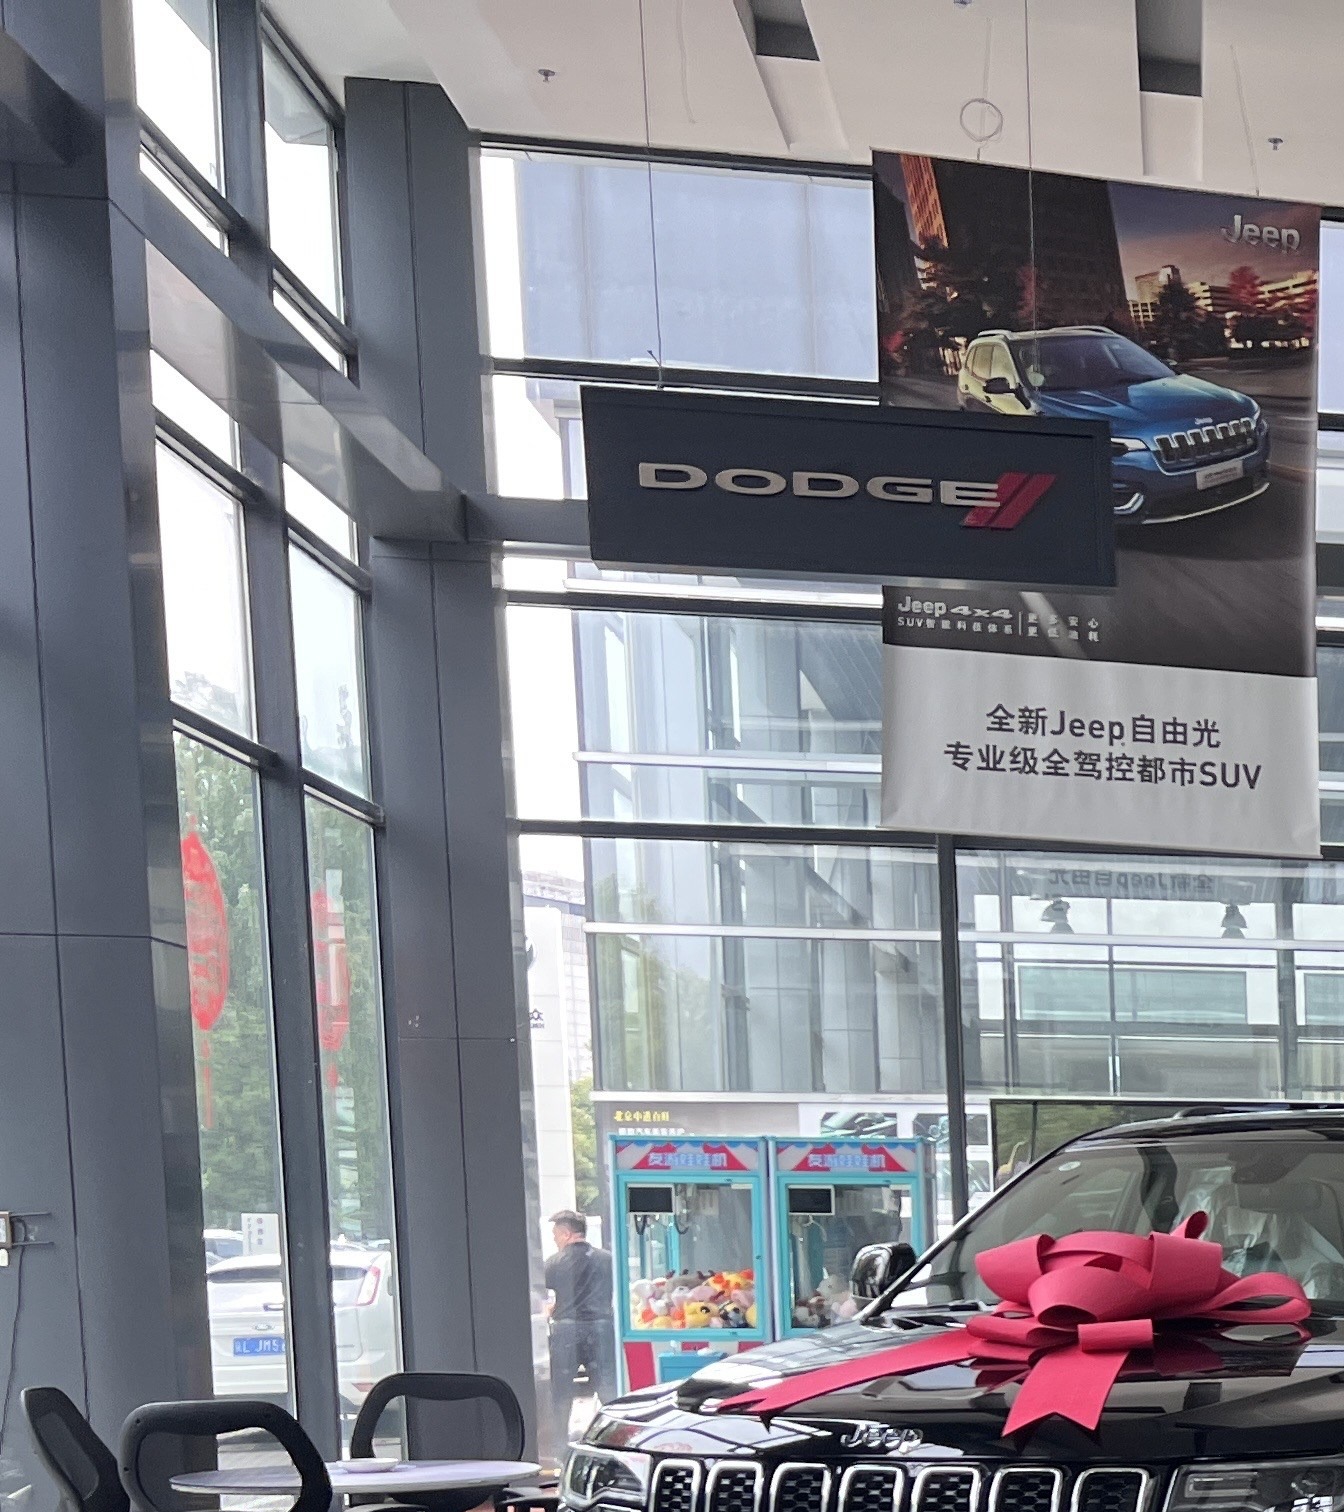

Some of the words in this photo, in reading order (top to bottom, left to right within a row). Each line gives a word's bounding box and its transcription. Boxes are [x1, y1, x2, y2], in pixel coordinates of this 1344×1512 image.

[1220, 214, 1300, 253] Jeep
[639, 462, 1000, 507] DODGE
[898, 596, 947, 617] Jeep
[950, 605, 1013, 619] 4x4
[985, 703, 1221, 749] 全新Jeep自由光
[943, 741, 1262, 790] 专业级全驾控都市SUV
[840, 1423, 923, 1453] Jeep
